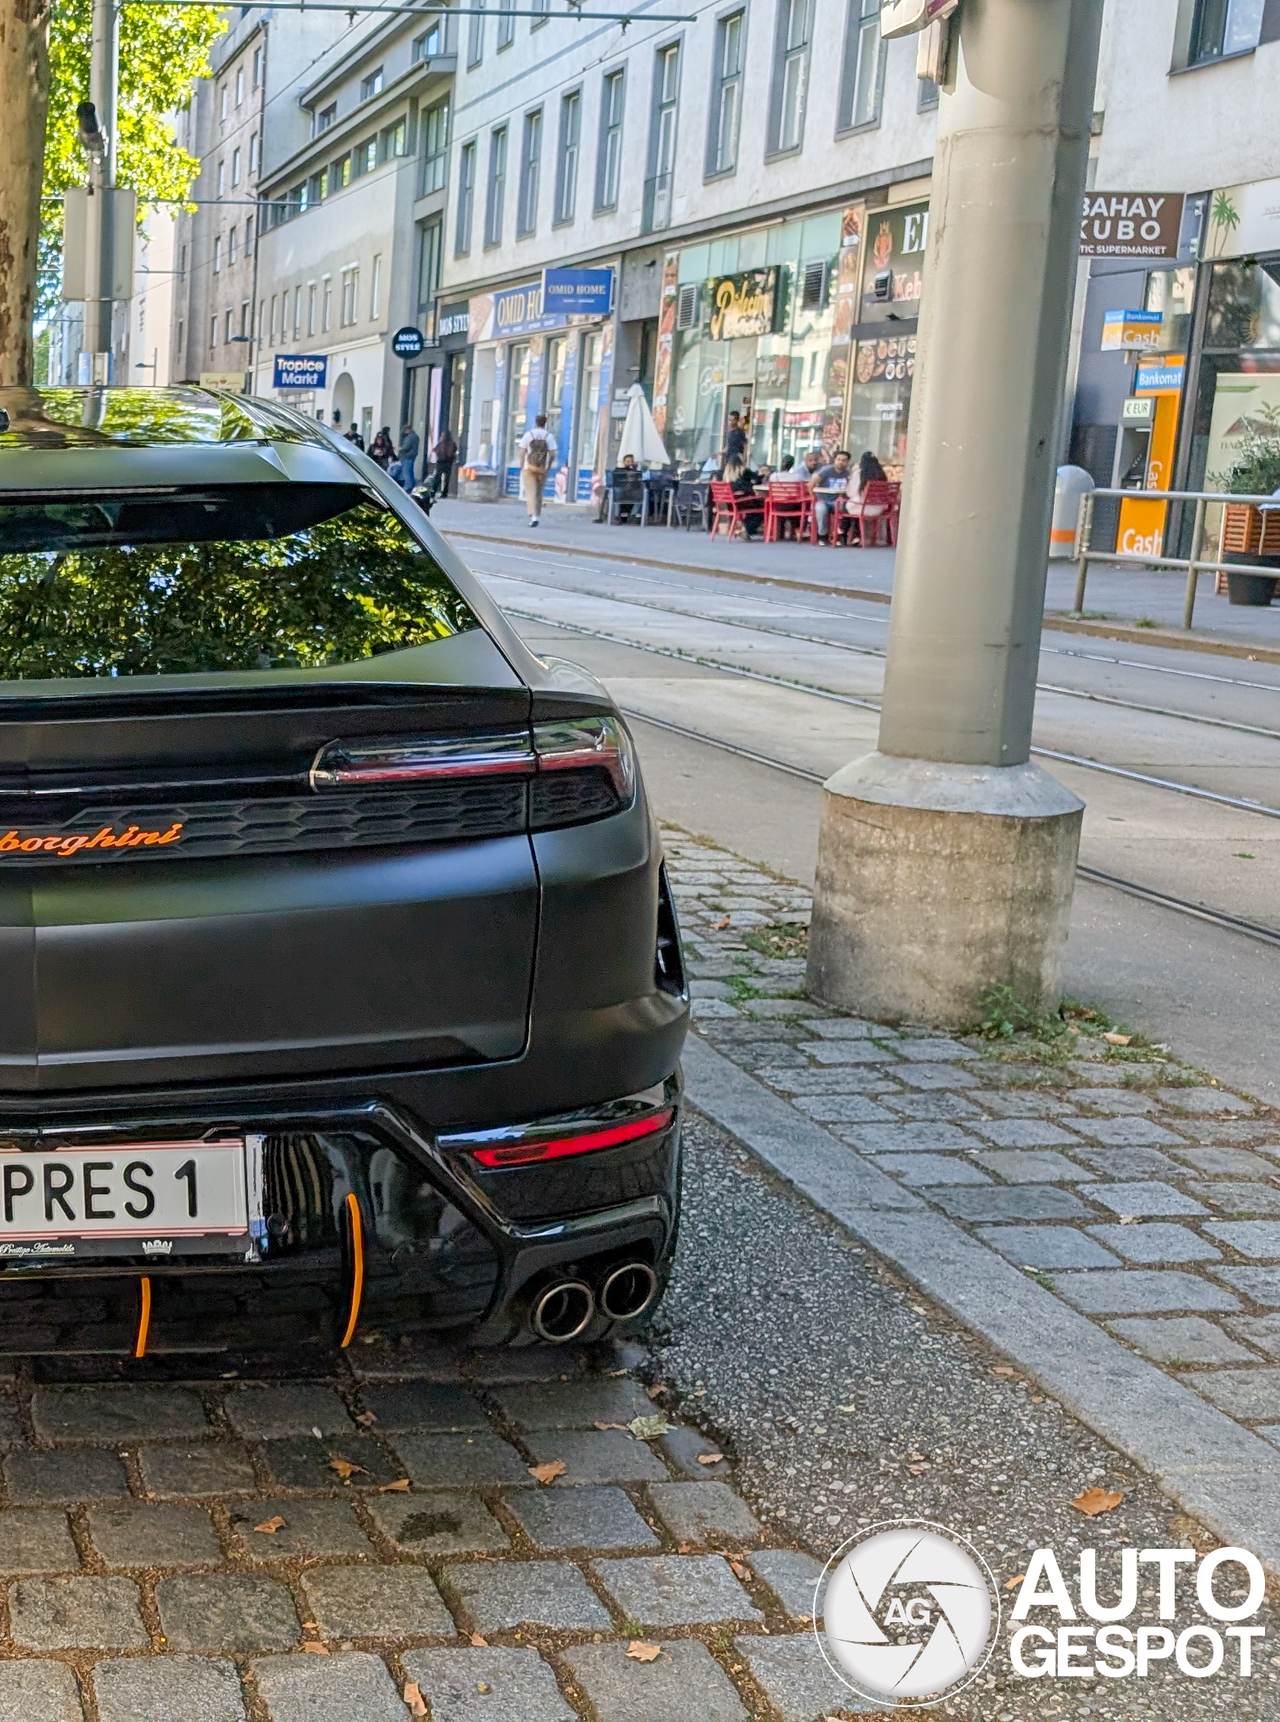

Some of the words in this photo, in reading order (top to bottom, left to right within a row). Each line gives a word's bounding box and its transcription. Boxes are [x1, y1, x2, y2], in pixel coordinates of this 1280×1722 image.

[1096, 244, 1167, 255] SUPERMARKET
[548, 285, 574, 295] OMID
[576, 285, 607, 295] HOME
[497, 294, 526, 327] OMID
[1122, 330, 1160, 344] Cash
[394, 342, 421, 351] STYLE
[281, 372, 319, 385] Markt
[1139, 371, 1182, 386] Bankomat
[1133, 402, 1149, 414] EUR
[1147, 461, 1163, 490] Cas
[1122, 528, 1163, 556] Cash
[3, 1160, 156, 1223] PRES
[174, 1158, 198, 1218] 1
